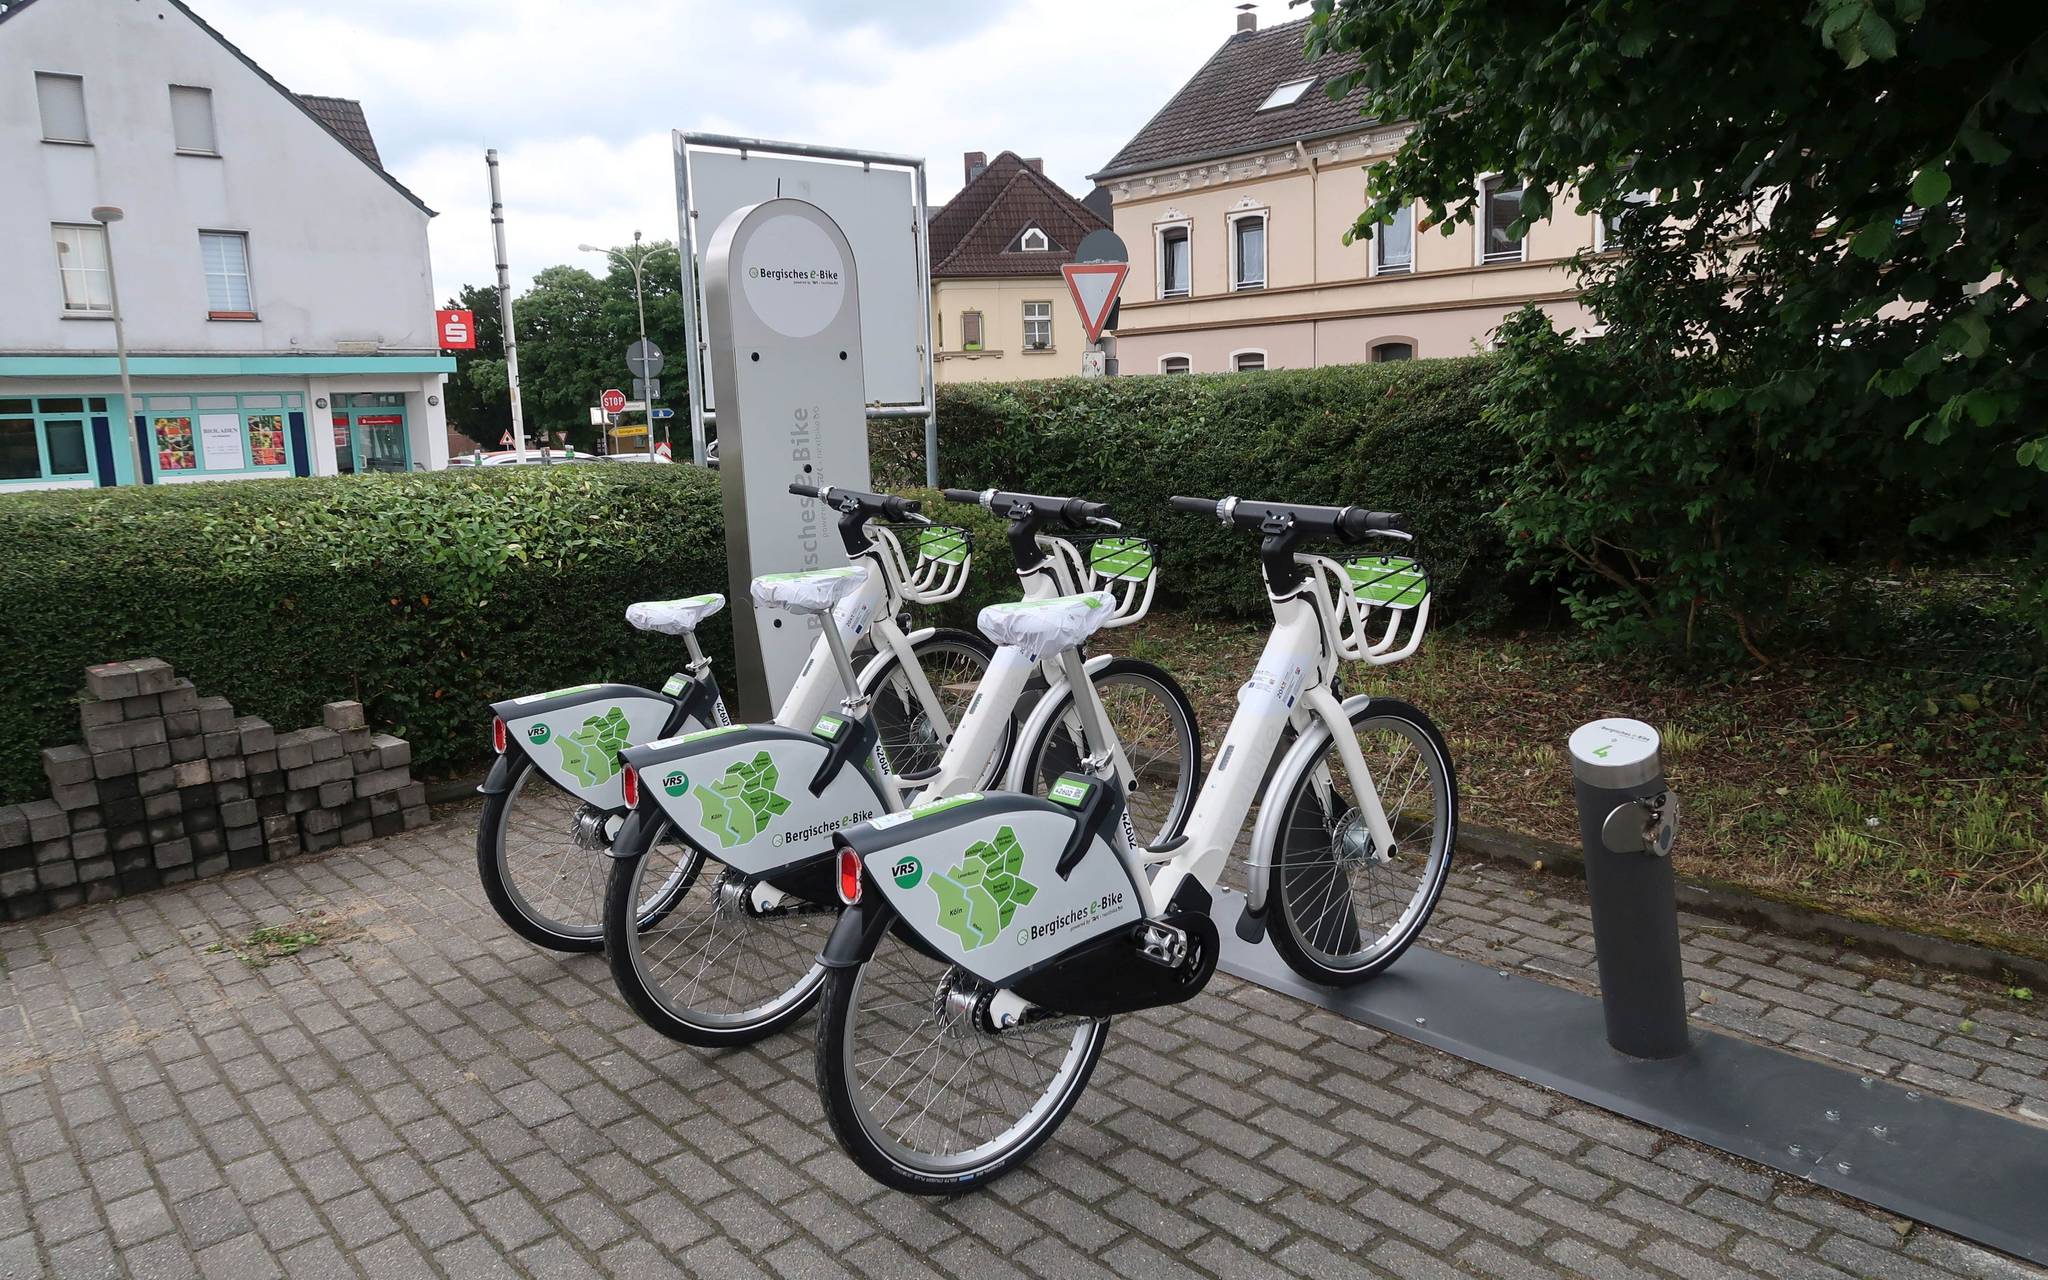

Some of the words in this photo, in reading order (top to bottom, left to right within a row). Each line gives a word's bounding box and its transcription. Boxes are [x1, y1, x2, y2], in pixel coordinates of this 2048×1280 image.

[760, 268, 809, 280] Bergisches
[810, 269, 838, 279] e-Bike
[604, 397, 623, 407] STOP
[528, 727, 545, 737] VRS
[1592, 745, 1613, 758] 4
[875, 745, 890, 775] 42604
[662, 775, 682, 787] VRS
[785, 820, 840, 843] Bergisches
[842, 810, 873, 827] e-Bike
[1121, 813, 1137, 850] 42602
[891, 862, 915, 877] VRS
[949, 908, 963, 916] Köln
[1031, 907, 1088, 940] Bergisches
[1090, 892, 1123, 914] e-Bike
